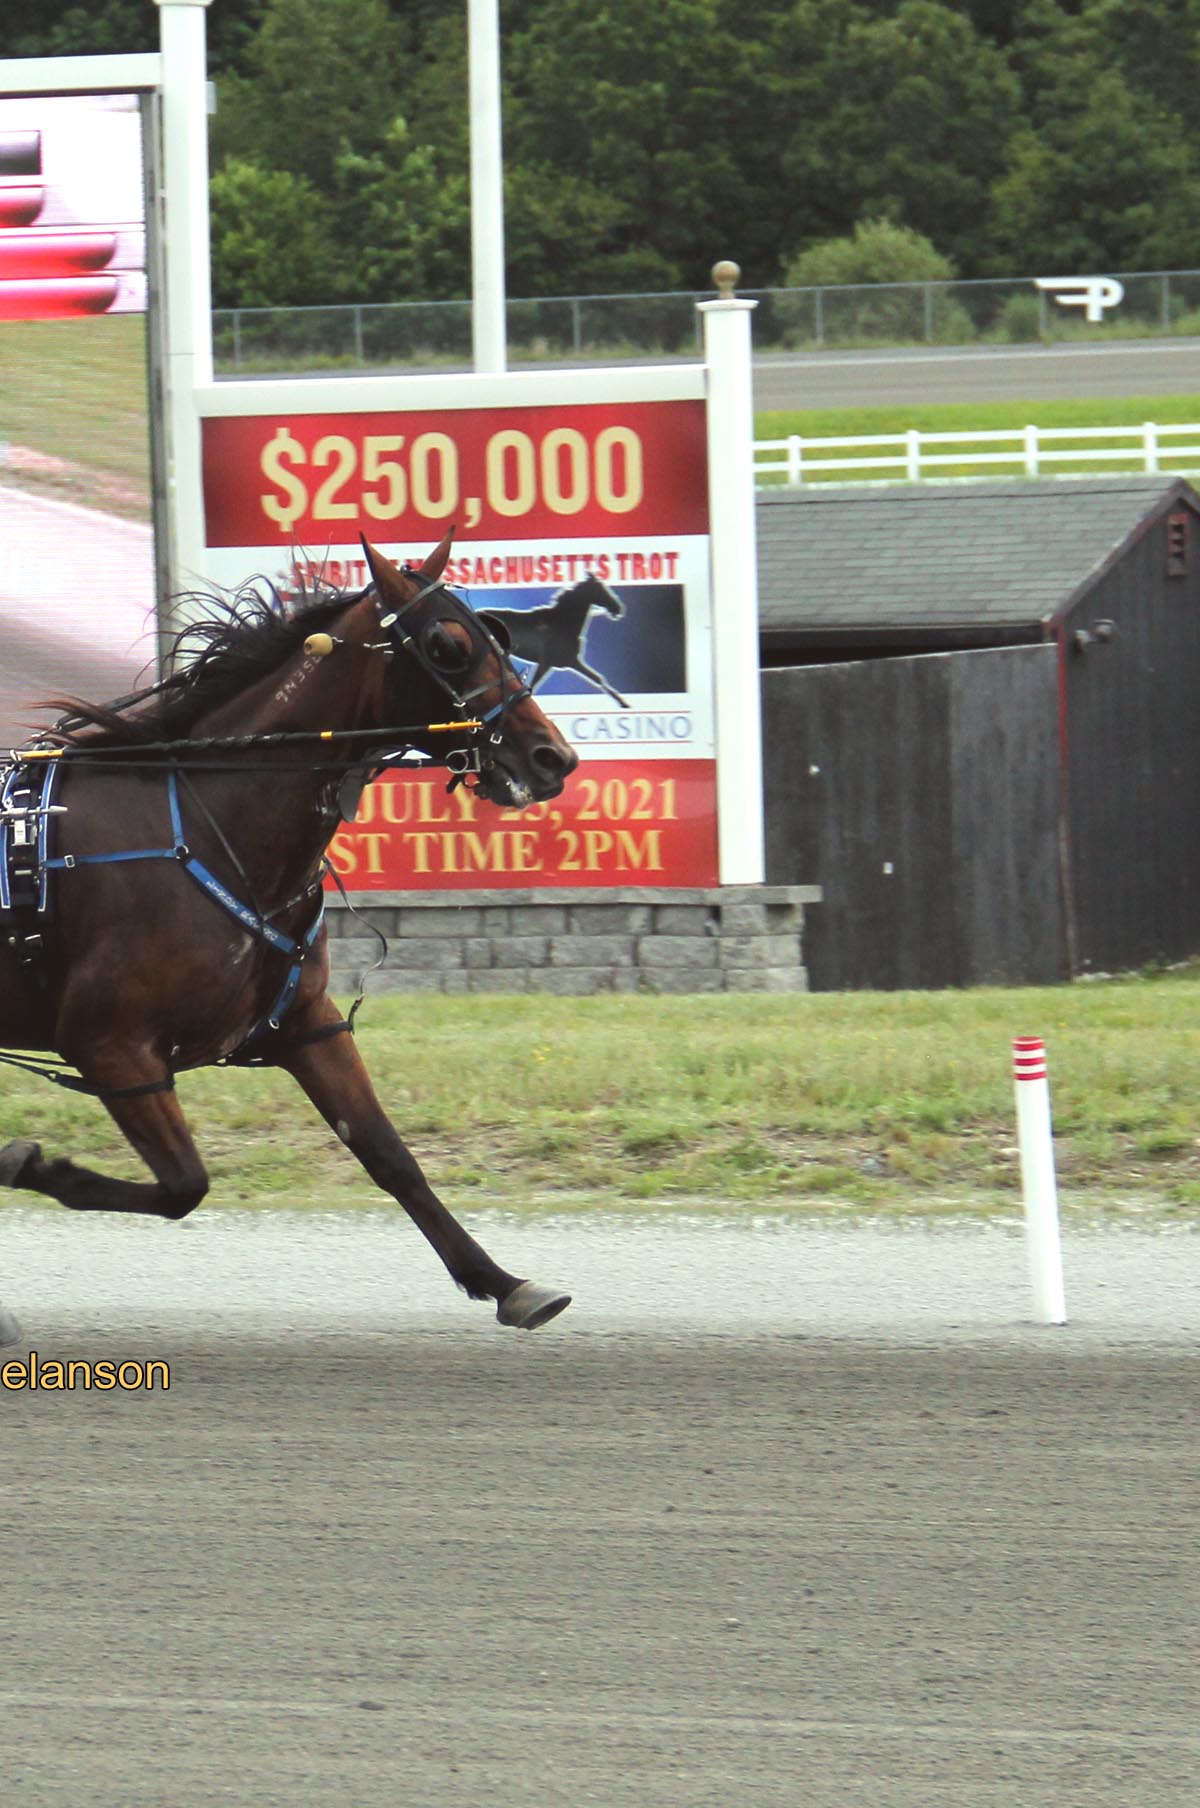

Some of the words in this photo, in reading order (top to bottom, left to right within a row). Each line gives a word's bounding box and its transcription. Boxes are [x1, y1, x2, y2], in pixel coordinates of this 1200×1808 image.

[260, 426, 644, 532] $250,000
[405, 551, 610, 586] SSACHUSETTS
[614, 551, 680, 580] TROT
[571, 716, 692, 740] CASINO
[354, 781, 482, 824] JULY
[575, 778, 680, 820] 2021
[402, 830, 544, 873] TIME
[556, 829, 663, 873] 2PM
